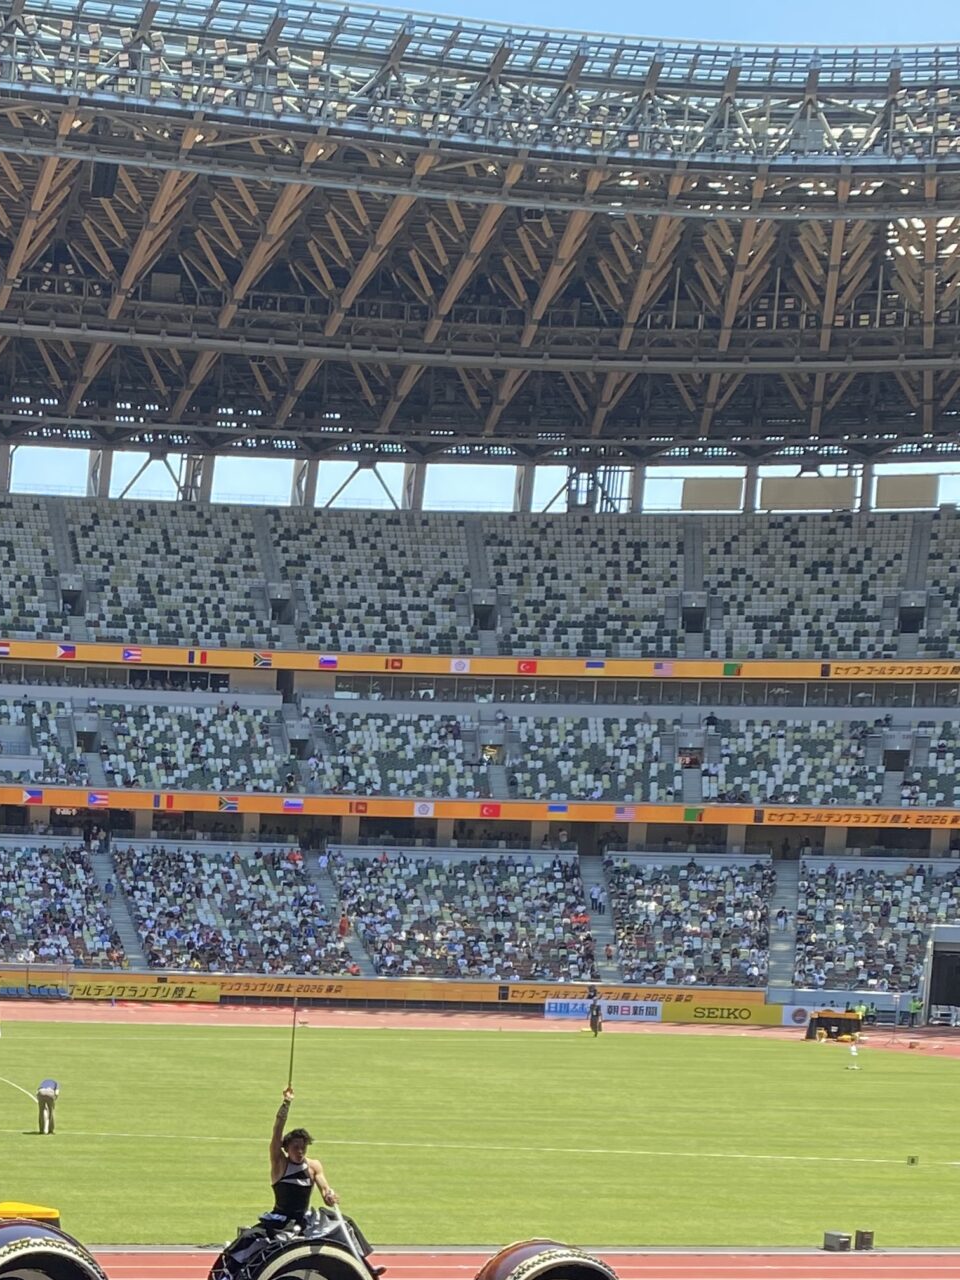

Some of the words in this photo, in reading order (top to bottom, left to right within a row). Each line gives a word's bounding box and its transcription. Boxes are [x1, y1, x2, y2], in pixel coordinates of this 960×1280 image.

[607, 1005, 658, 1017] 朝日新聞
[694, 1007, 751, 1020] SEIKO
